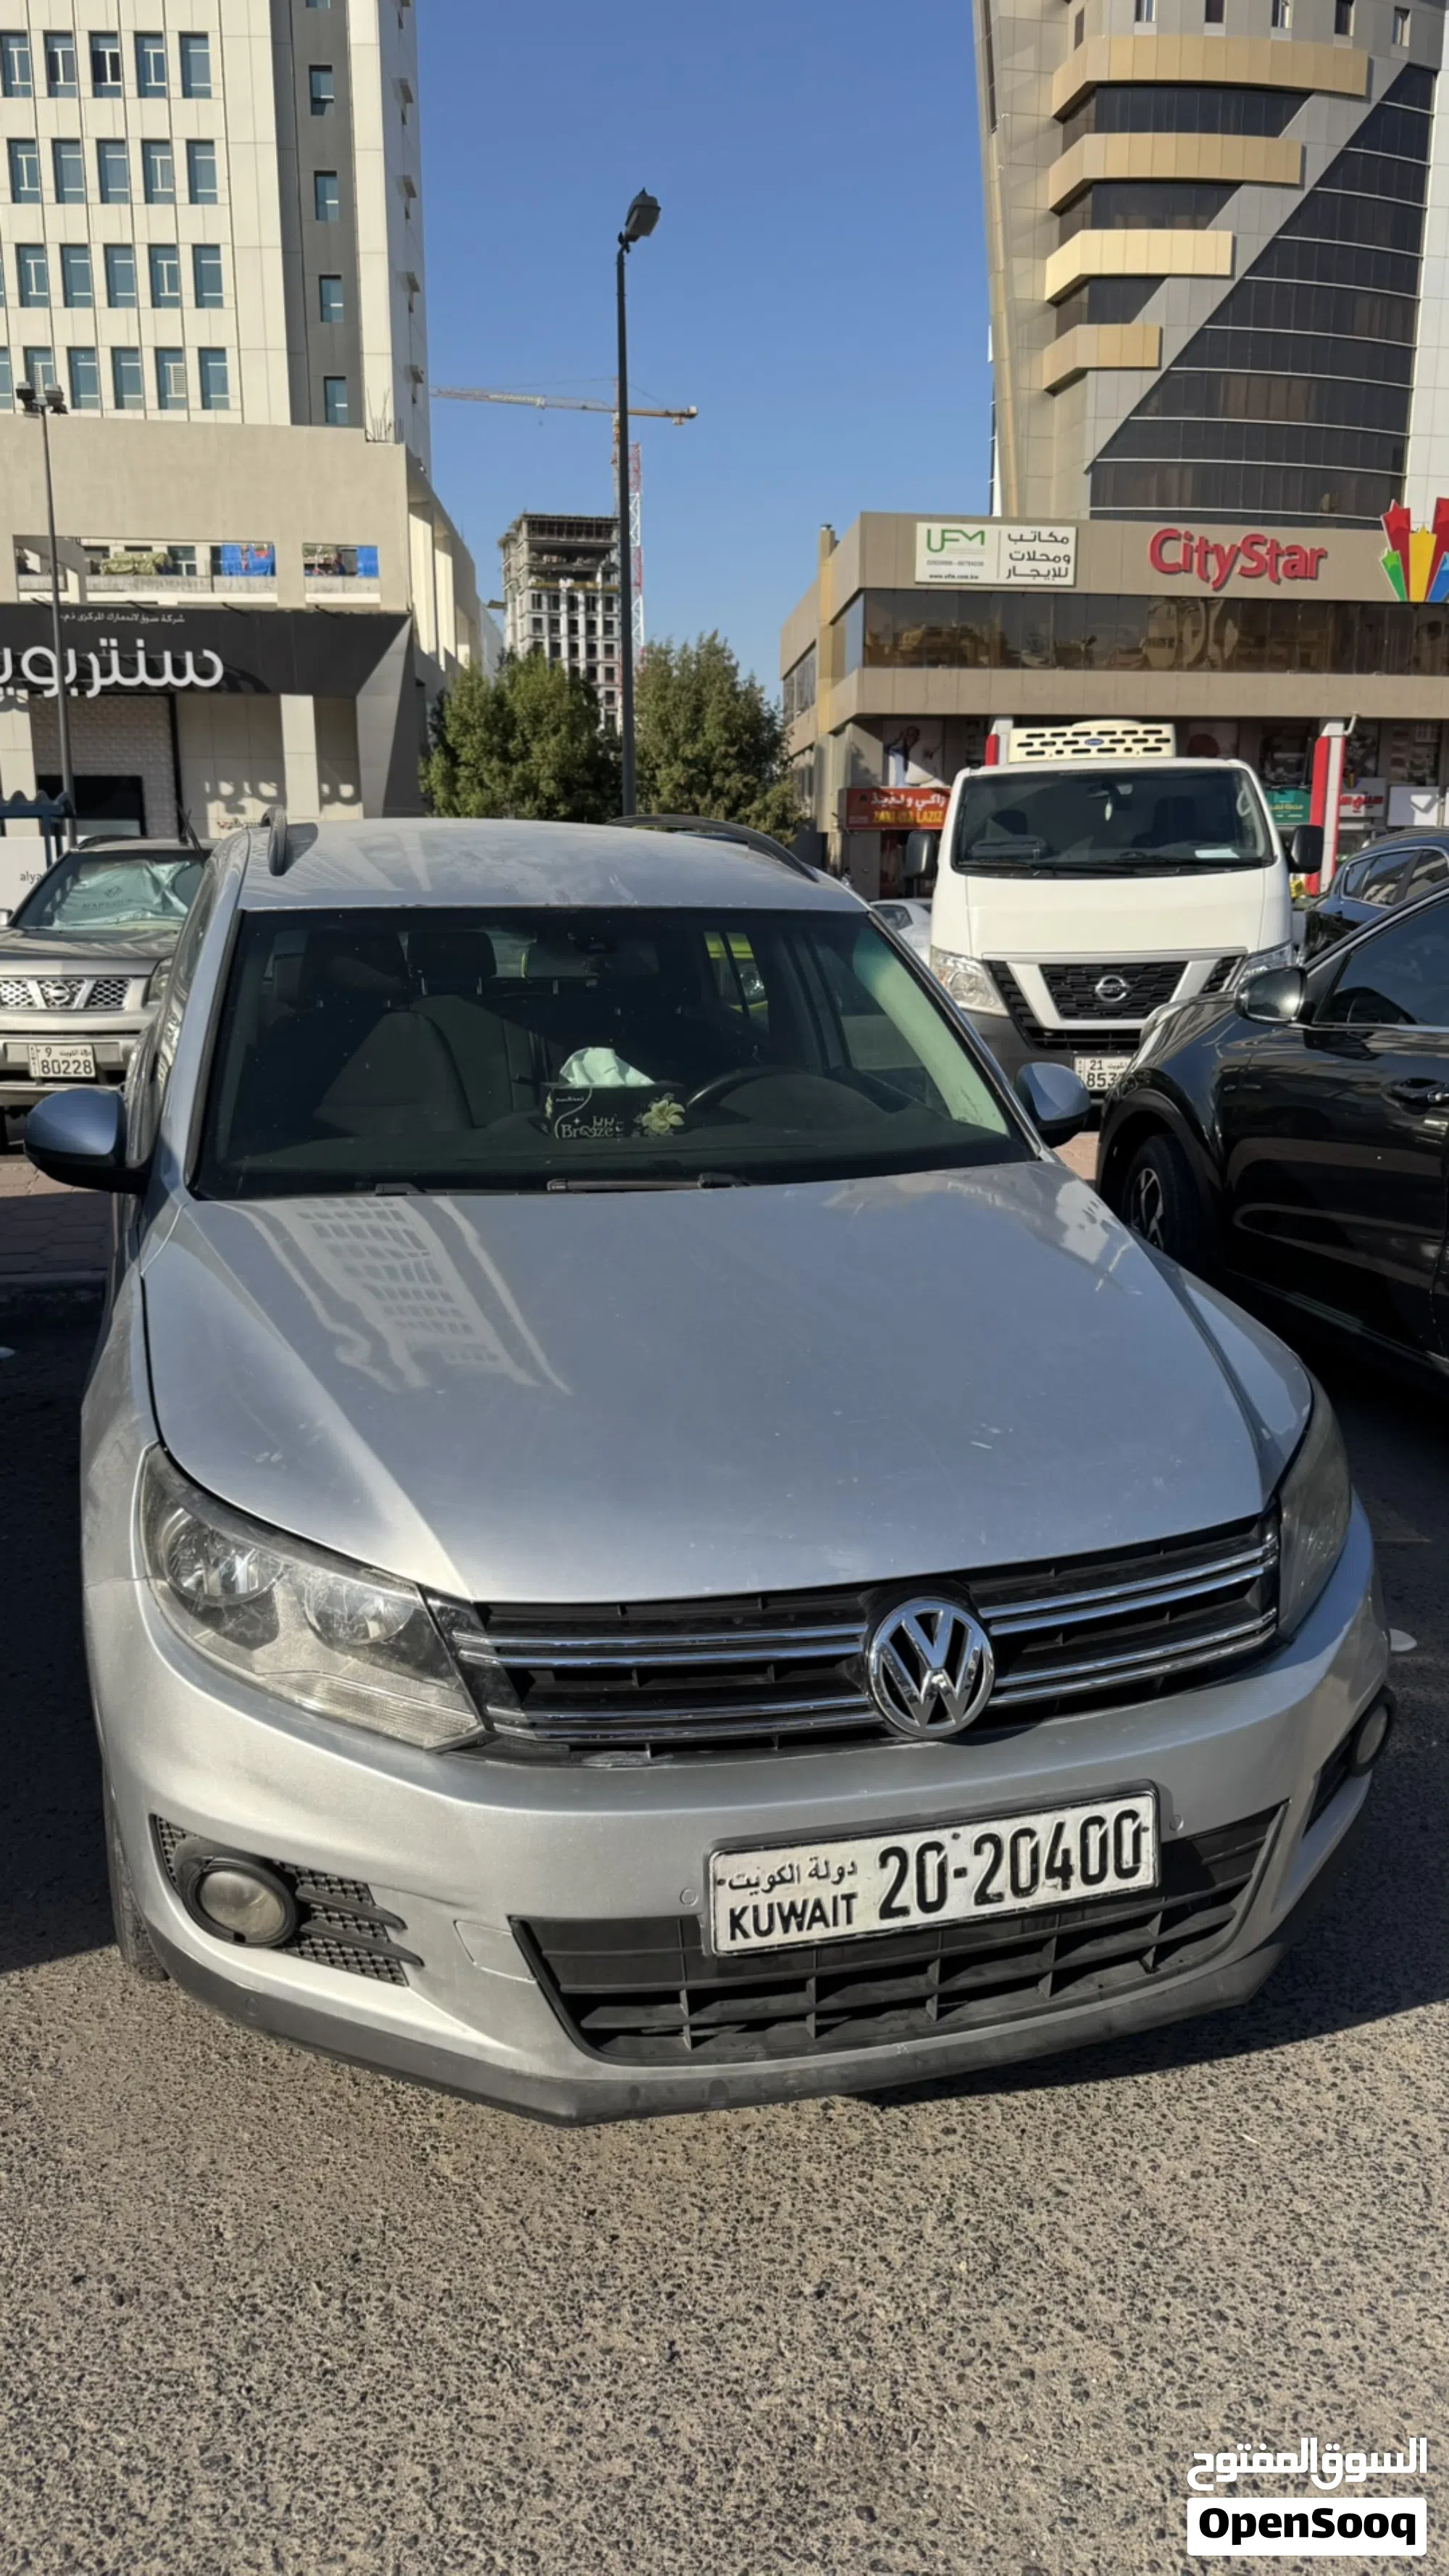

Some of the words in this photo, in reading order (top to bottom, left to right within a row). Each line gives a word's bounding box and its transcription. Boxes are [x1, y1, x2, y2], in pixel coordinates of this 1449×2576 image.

[1008, 531, 1069, 545] مكاتب
[1009, 551, 1071, 565] ومحلات
[1006, 566, 1069, 582] للإيجار
[161, 613, 185, 625] شركة
[45, 1047, 52, 1058] 9
[41, 1059, 92, 1075] 80228
[1090, 1059, 1103, 1071] 21
[809, 1857, 858, 1885] دولة
[878, 1809, 1143, 1920] 20-20400
[727, 1864, 801, 1894] الكويت
[729, 1892, 858, 1941] KUWAIT
